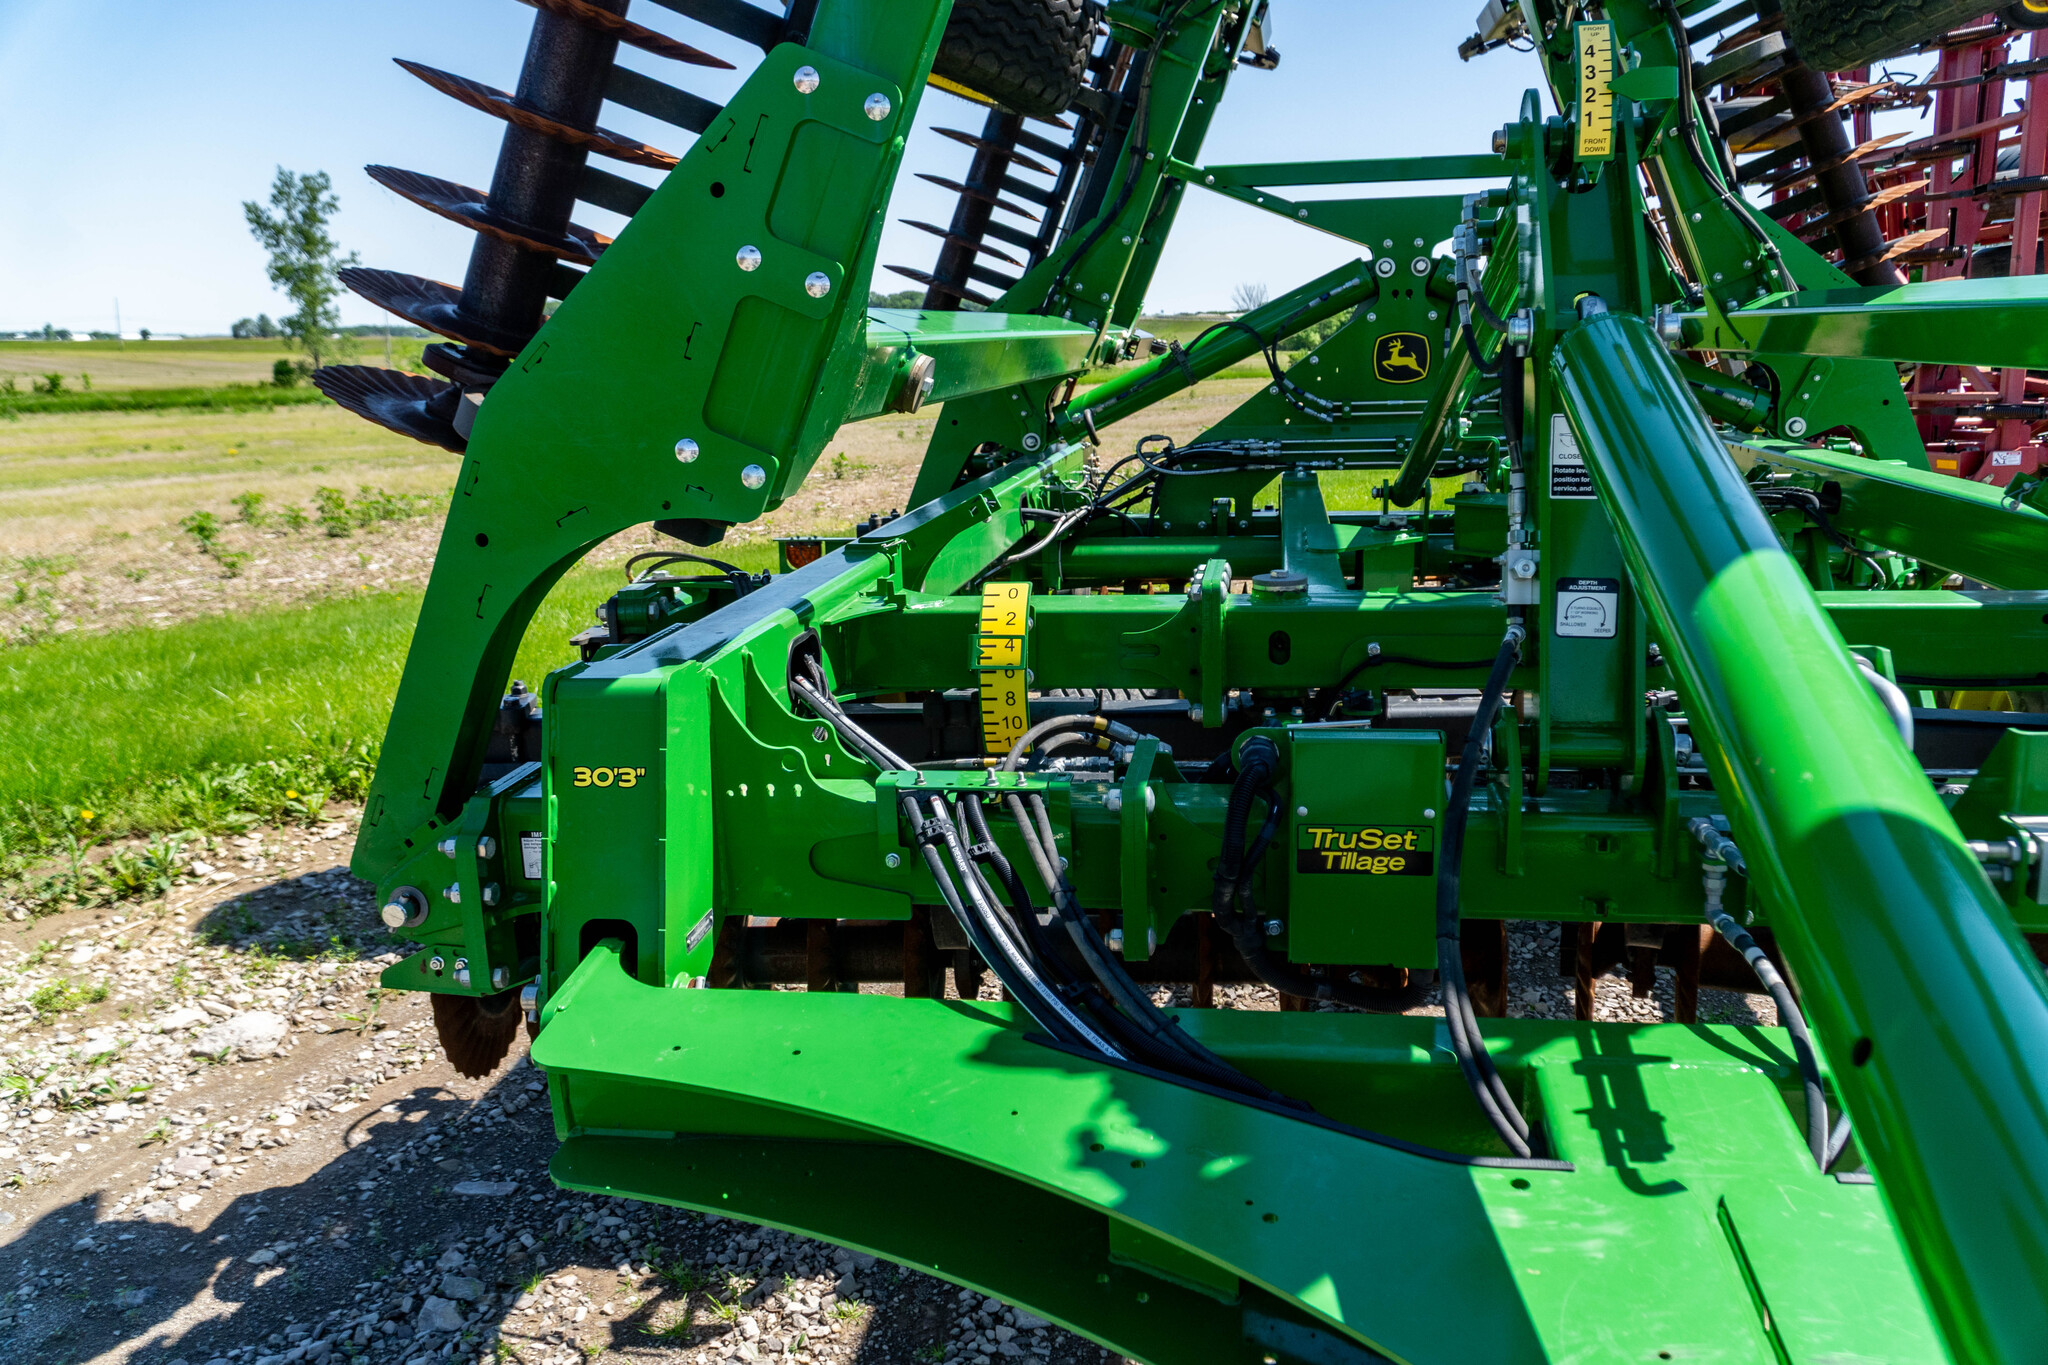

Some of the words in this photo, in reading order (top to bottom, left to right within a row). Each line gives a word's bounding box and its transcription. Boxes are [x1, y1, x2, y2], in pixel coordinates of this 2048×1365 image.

[1584, 44, 1596, 58] 4
[1585, 65, 1596, 80] 3
[1585, 87, 1596, 103] 2
[1584, 111, 1592, 127] 1
[1553, 476, 1580, 484] position
[1008, 588, 1019, 599] 0
[1006, 612, 1016, 626] 2
[1004, 639, 1015, 652] 4
[1006, 691, 1016, 707] 8
[1002, 716, 1023, 730] 10
[1004, 736, 1021, 748] 1
[573, 766, 646, 788] 30'3"
[1307, 828, 1418, 851] TruSet
[1320, 851, 1406, 875] Tillage
